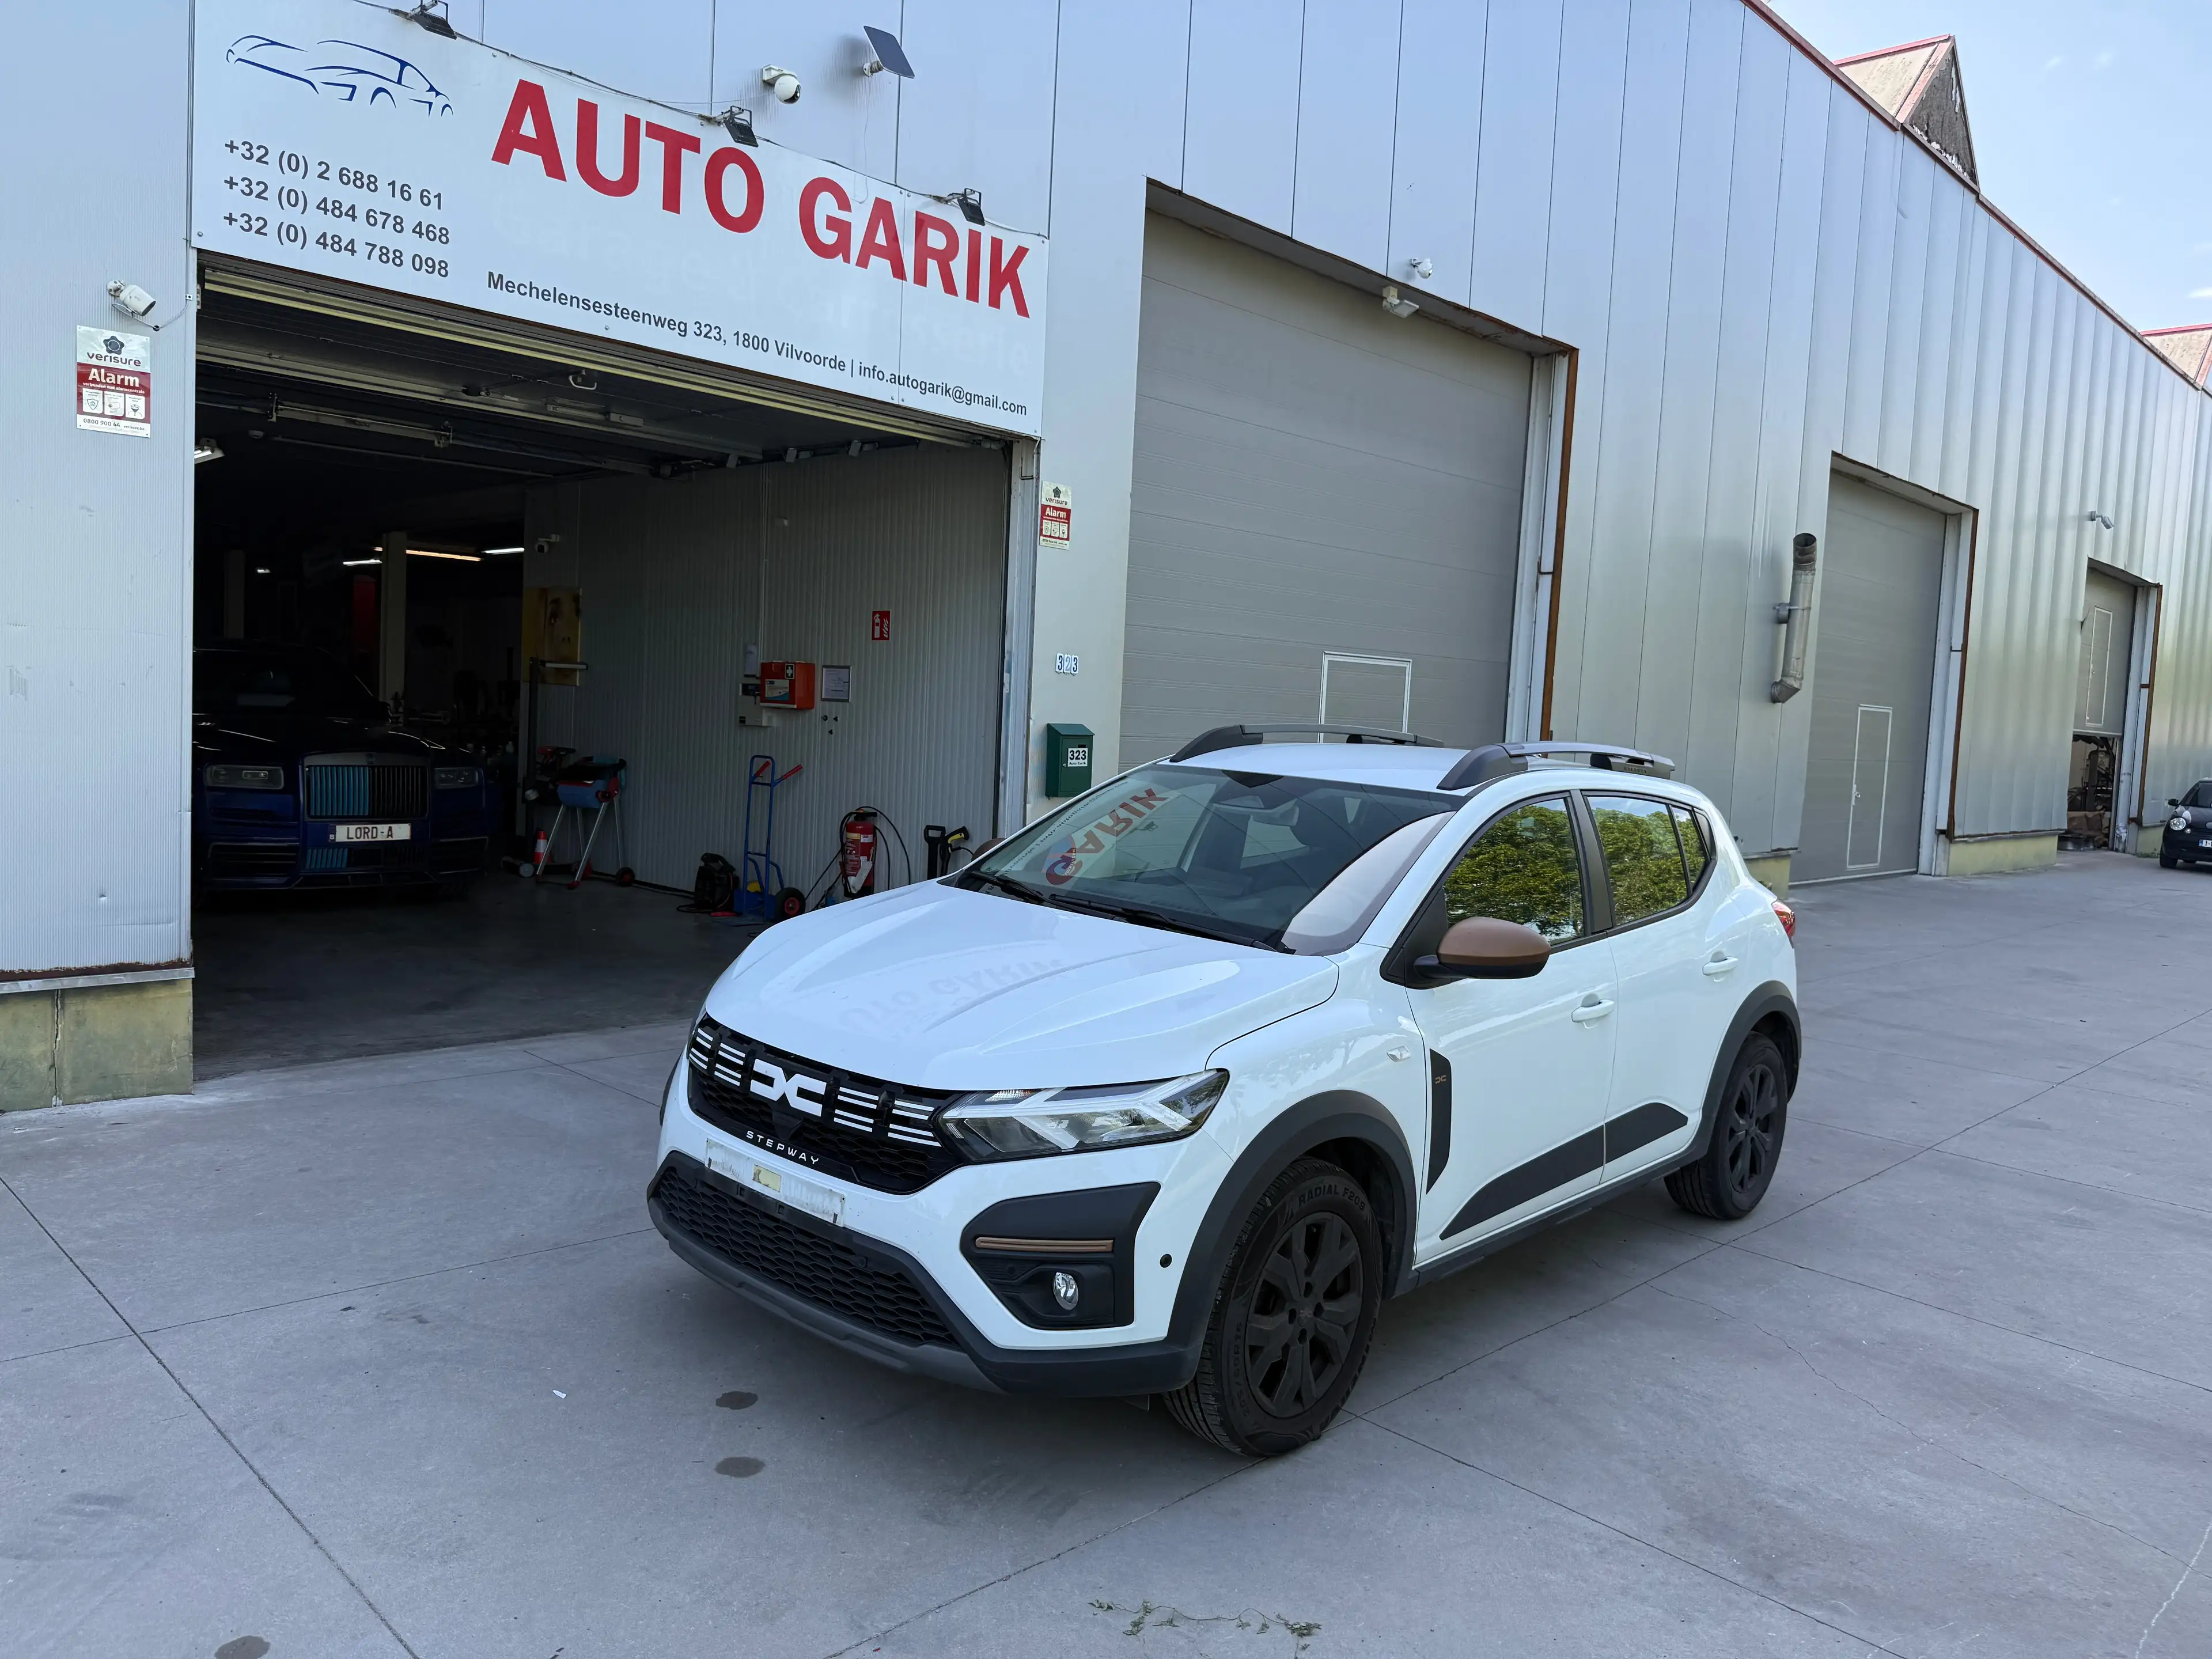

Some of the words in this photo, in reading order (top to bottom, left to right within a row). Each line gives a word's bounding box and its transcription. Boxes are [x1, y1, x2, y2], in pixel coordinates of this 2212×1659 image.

[225, 140, 269, 165] +32
[278, 150, 308, 179] (0)
[317, 161, 330, 181] 2
[338, 167, 378, 194] 688
[387, 180, 412, 202] 16
[419, 189, 443, 210] 61
[224, 176, 269, 201] +32
[278, 185, 308, 215] (0)
[316, 196, 357, 222] 484
[365, 210, 404, 234] 678
[412, 221, 450, 245] 468
[491, 78, 764, 233] AUTO
[799, 177, 1030, 319] GARIK
[223, 212, 268, 237] +32
[277, 221, 307, 250] (0)
[316, 232, 357, 256] 484
[365, 243, 403, 267] 788
[411, 254, 449, 278] 098
[487, 271, 688, 337] Mechelensesteenweg
[694, 321, 727, 346] 323,
[733, 331, 769, 353] 1800
[774, 340, 846, 372] Vilvoorde
[859, 362, 1027, 416] info.autogarik@gmail.com
[87, 352, 141, 367] verisure
[88, 368, 139, 387] Alarm
[1046, 497, 1068, 506] verisure
[1046, 507, 1066, 518] Alarm
[1058, 655, 1078, 672] 323
[1069, 749, 1086, 760] 323
[746, 1130, 819, 1165] STEPWAY
[1298, 1184, 1339, 1207] RADIAL
[1342, 1187, 1366, 1211] F209
